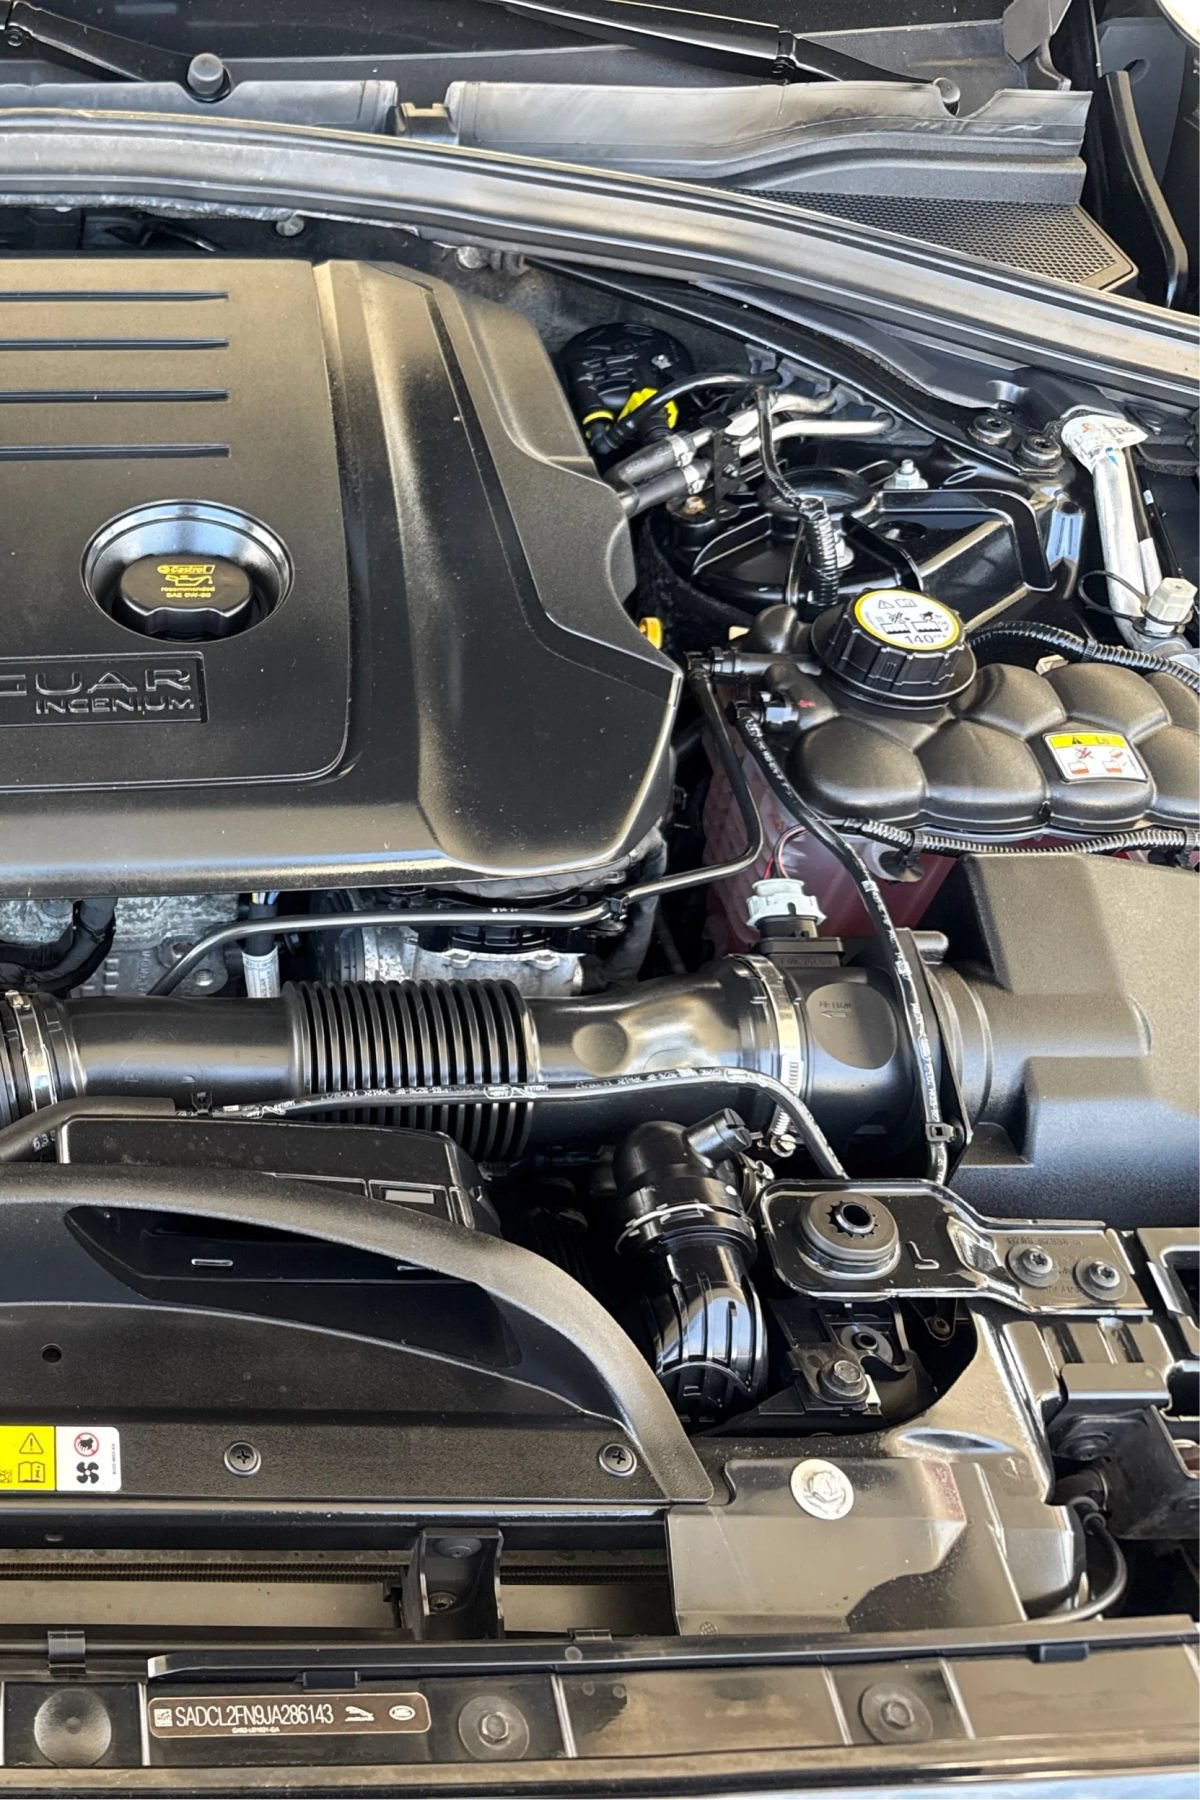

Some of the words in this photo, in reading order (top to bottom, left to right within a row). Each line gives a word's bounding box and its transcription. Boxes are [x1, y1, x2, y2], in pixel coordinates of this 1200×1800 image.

[903, 634, 935, 645] 140
[34, 696, 195, 715] INGENIUM
[905, 1239, 940, 1270] L
[174, 1703, 335, 1727] SADCL2FN9JA286143
